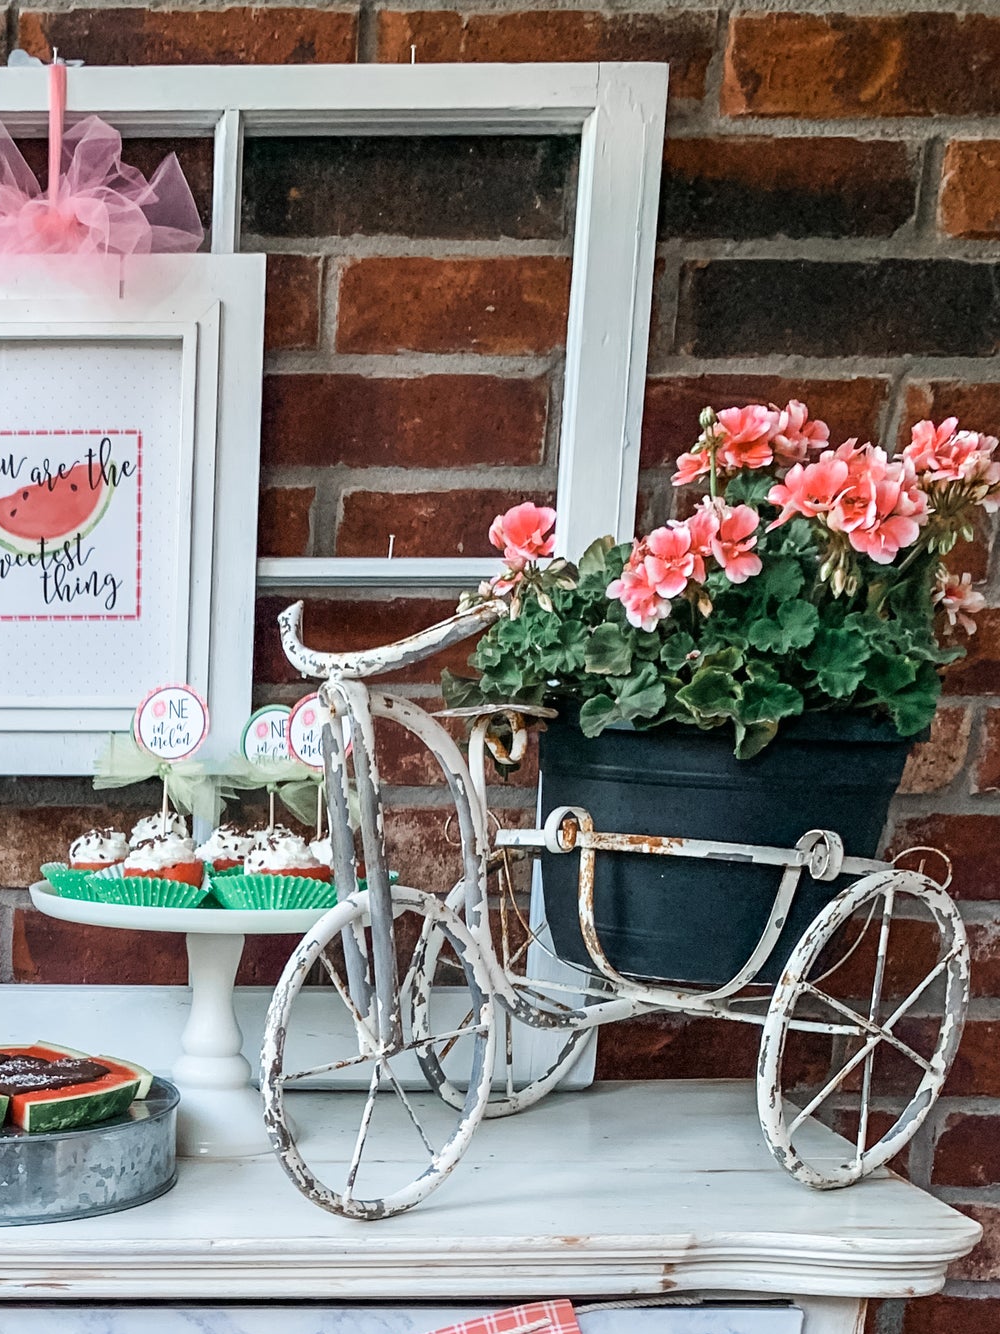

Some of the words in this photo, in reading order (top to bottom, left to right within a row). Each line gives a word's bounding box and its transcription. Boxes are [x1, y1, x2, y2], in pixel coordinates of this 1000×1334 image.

[30, 458, 80, 492] are
[84, 437, 137, 490] the
[40, 562, 123, 610] thing
[152, 721, 169, 736] in
[176, 721, 187, 731] a
[302, 730, 319, 743] in
[150, 728, 194, 750] melon
[256, 741, 272, 754] in
